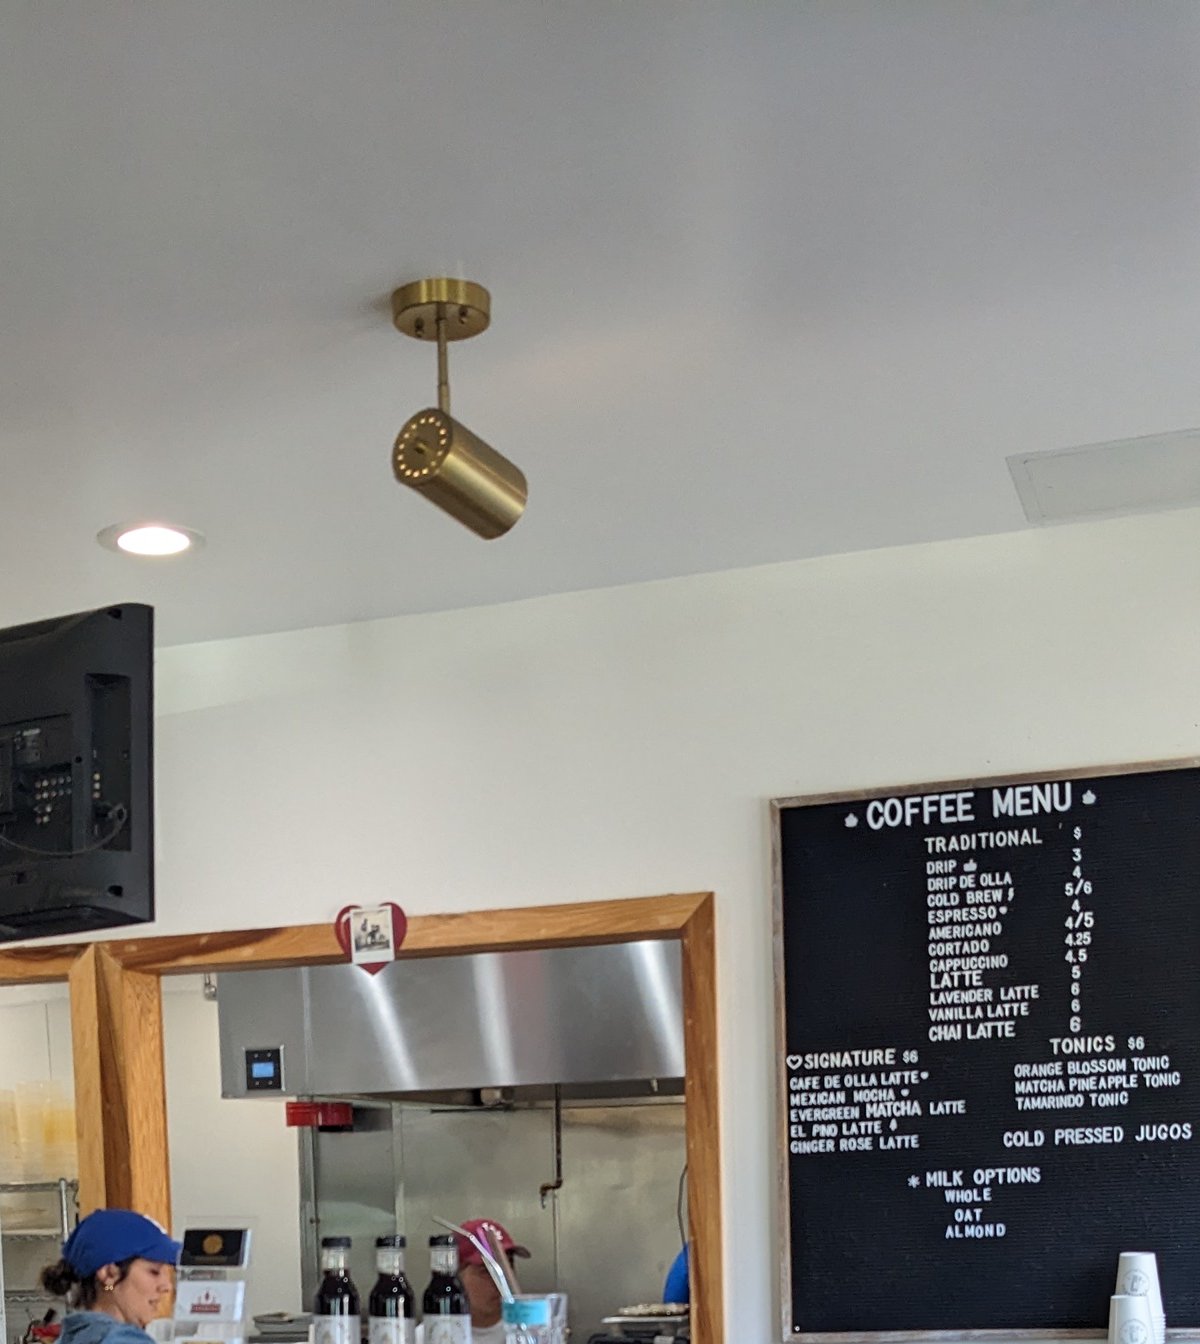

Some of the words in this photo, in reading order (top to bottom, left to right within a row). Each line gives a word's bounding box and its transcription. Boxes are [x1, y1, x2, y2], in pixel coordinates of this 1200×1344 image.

[866, 793, 975, 830] COFFEE
[992, 783, 1072, 818] MENU
[925, 828, 1043, 854] TRADITIONAL
[1072, 848, 1082, 862] 3
[926, 860, 957, 875] DRIP
[1072, 866, 1082, 879] 4
[927, 878, 959, 891] DRIP
[959, 875, 976, 889] DE
[980, 873, 1012, 887] OLLA
[1065, 881, 1092, 896] 5/6
[927, 893, 959, 907] COLD
[966, 890, 1003, 904] BREW
[1071, 900, 1080, 912] 4
[928, 907, 997, 924] ESPRESSO
[1065, 913, 1094, 929] 4/5
[928, 923, 1002, 940] AMERICANO
[1065, 933, 1091, 946] 4.25
[928, 940, 990, 957] CORTADO
[1065, 949, 1087, 964] 4.5
[930, 955, 1008, 972] CAPPUCCINO
[931, 971, 983, 989] LATTE
[1071, 966, 1080, 979] 5
[931, 989, 993, 1005] LAVENDER
[1000, 986, 1039, 1001] LATTE
[1071, 983, 1080, 996] 6
[928, 1005, 983, 1021] VANILLA
[987, 1003, 1029, 1018] LATTE
[1071, 999, 1080, 1013] 6
[928, 1023, 962, 1042] CHAI
[967, 1022, 1016, 1039] LATTE
[1069, 1017, 1081, 1033] 6
[1049, 1037, 1115, 1055] TONICS
[1128, 1036, 1145, 1050] $6
[805, 1049, 896, 1070] SIGNATURE
[902, 1050, 918, 1064] $6
[1014, 1063, 1063, 1078] ORANGE
[1068, 1059, 1126, 1075] BLOSSOM
[1131, 1056, 1170, 1071] TONIC
[790, 1076, 820, 1090] CAFE
[825, 1075, 841, 1088] DE
[845, 1074, 878, 1087] OLLA
[880, 1071, 920, 1085] LATTE
[1015, 1078, 1065, 1094] MATCHA
[1069, 1074, 1138, 1091] PINEAPPLE
[1144, 1072, 1181, 1087] TONIC
[790, 1091, 845, 1106] MEXICAN
[854, 1089, 895, 1103] MOCHA
[1016, 1095, 1084, 1110] TAMARINDO
[1091, 1092, 1129, 1107] TONIC
[790, 1106, 859, 1122] EVERGREEN
[866, 1100, 921, 1118] MATCHA
[929, 1100, 966, 1115] LATTE
[791, 1125, 806, 1138] EL
[841, 1121, 882, 1135] LATTE
[1003, 1129, 1044, 1148] COLD
[1055, 1127, 1123, 1145] PRESSED
[1135, 1124, 1192, 1142] JUGOS
[790, 1139, 835, 1154] GINGER
[839, 1138, 873, 1151] ROSE
[879, 1135, 920, 1149] LATTE
[926, 1171, 963, 1188] MILK
[973, 1167, 1041, 1185] OPTIONS
[945, 1188, 992, 1203] WHOLE
[955, 1209, 983, 1222] OAT
[945, 1224, 1006, 1239] ALMOND
